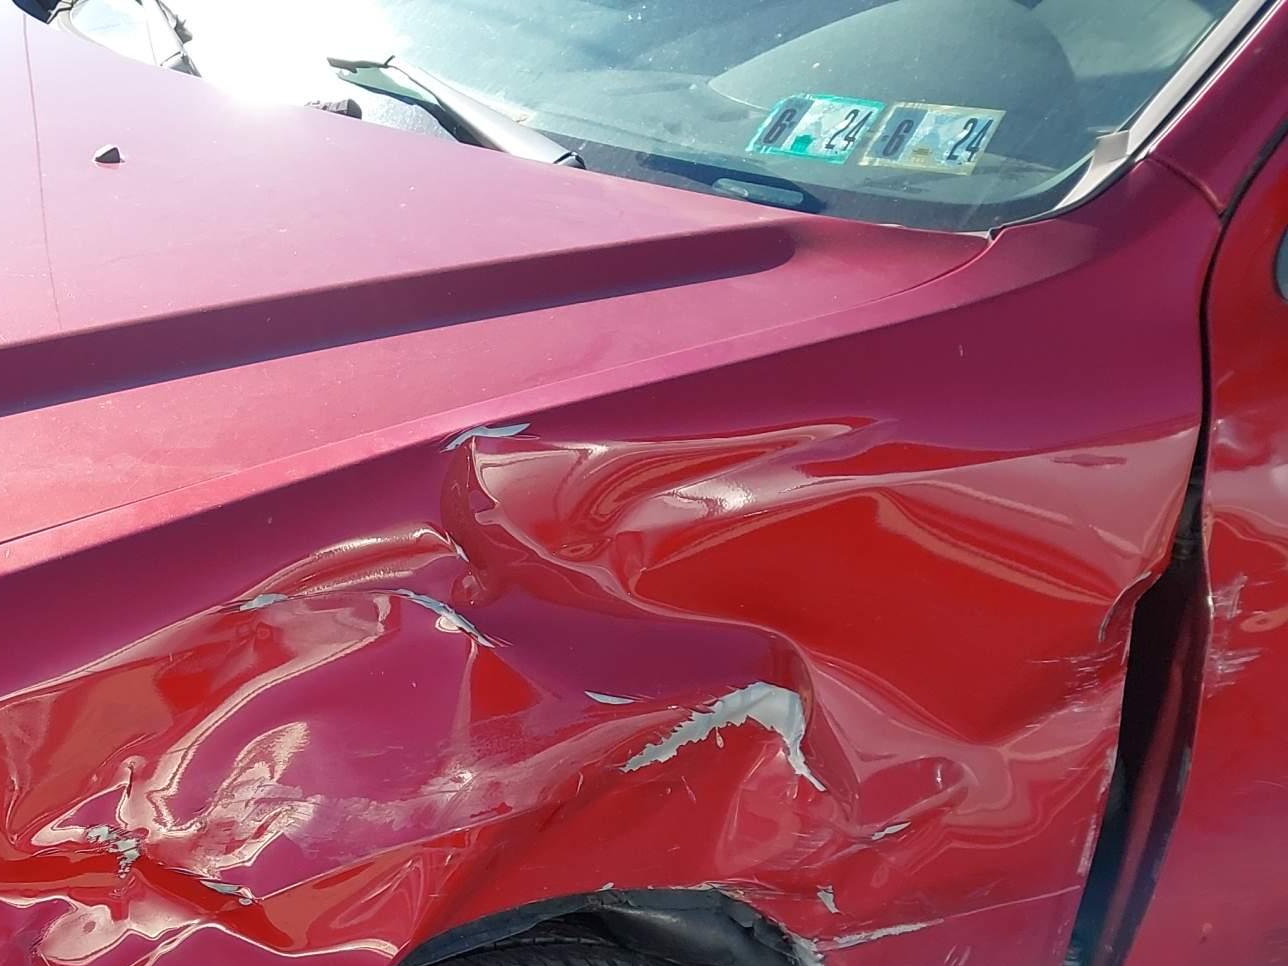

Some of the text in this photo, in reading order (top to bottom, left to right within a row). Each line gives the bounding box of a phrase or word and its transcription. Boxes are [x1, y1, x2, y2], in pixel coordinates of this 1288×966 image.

[763, 108, 874, 152] 6 24
[883, 117, 994, 162] 6 24
